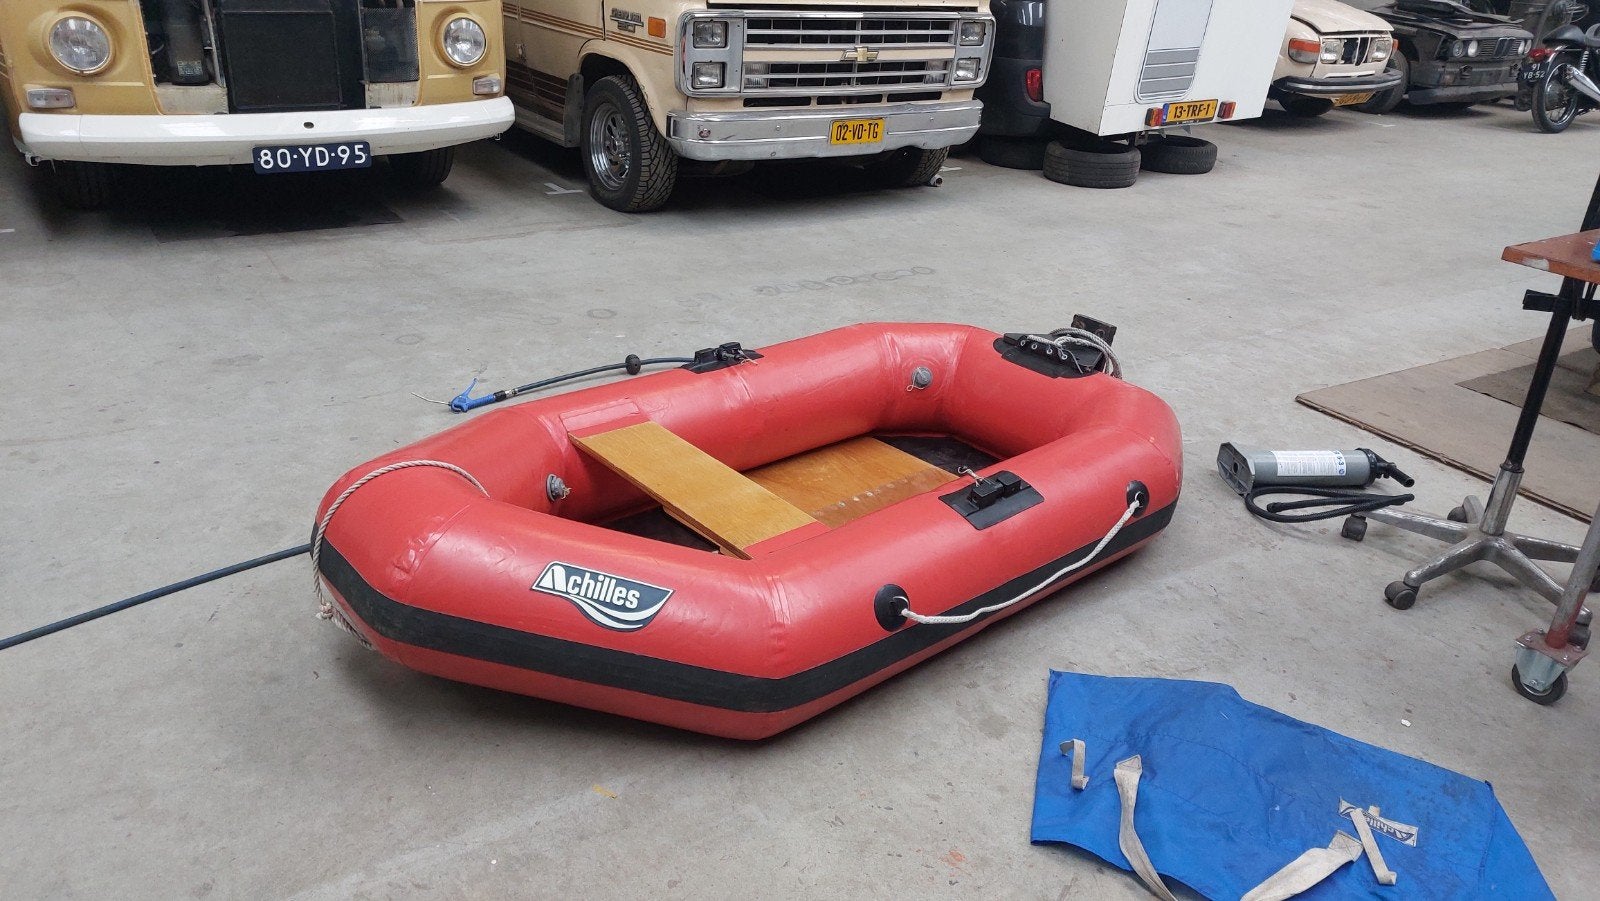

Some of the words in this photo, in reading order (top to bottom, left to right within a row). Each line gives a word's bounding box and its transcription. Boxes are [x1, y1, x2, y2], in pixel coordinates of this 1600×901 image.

[1531, 63, 1541, 71] 91
[1173, 103, 1211, 119] 13-TRF-1
[836, 122, 879, 142] 02-VD-TG
[538, 564, 641, 609] Achilles
[1366, 816, 1411, 840] Achille
